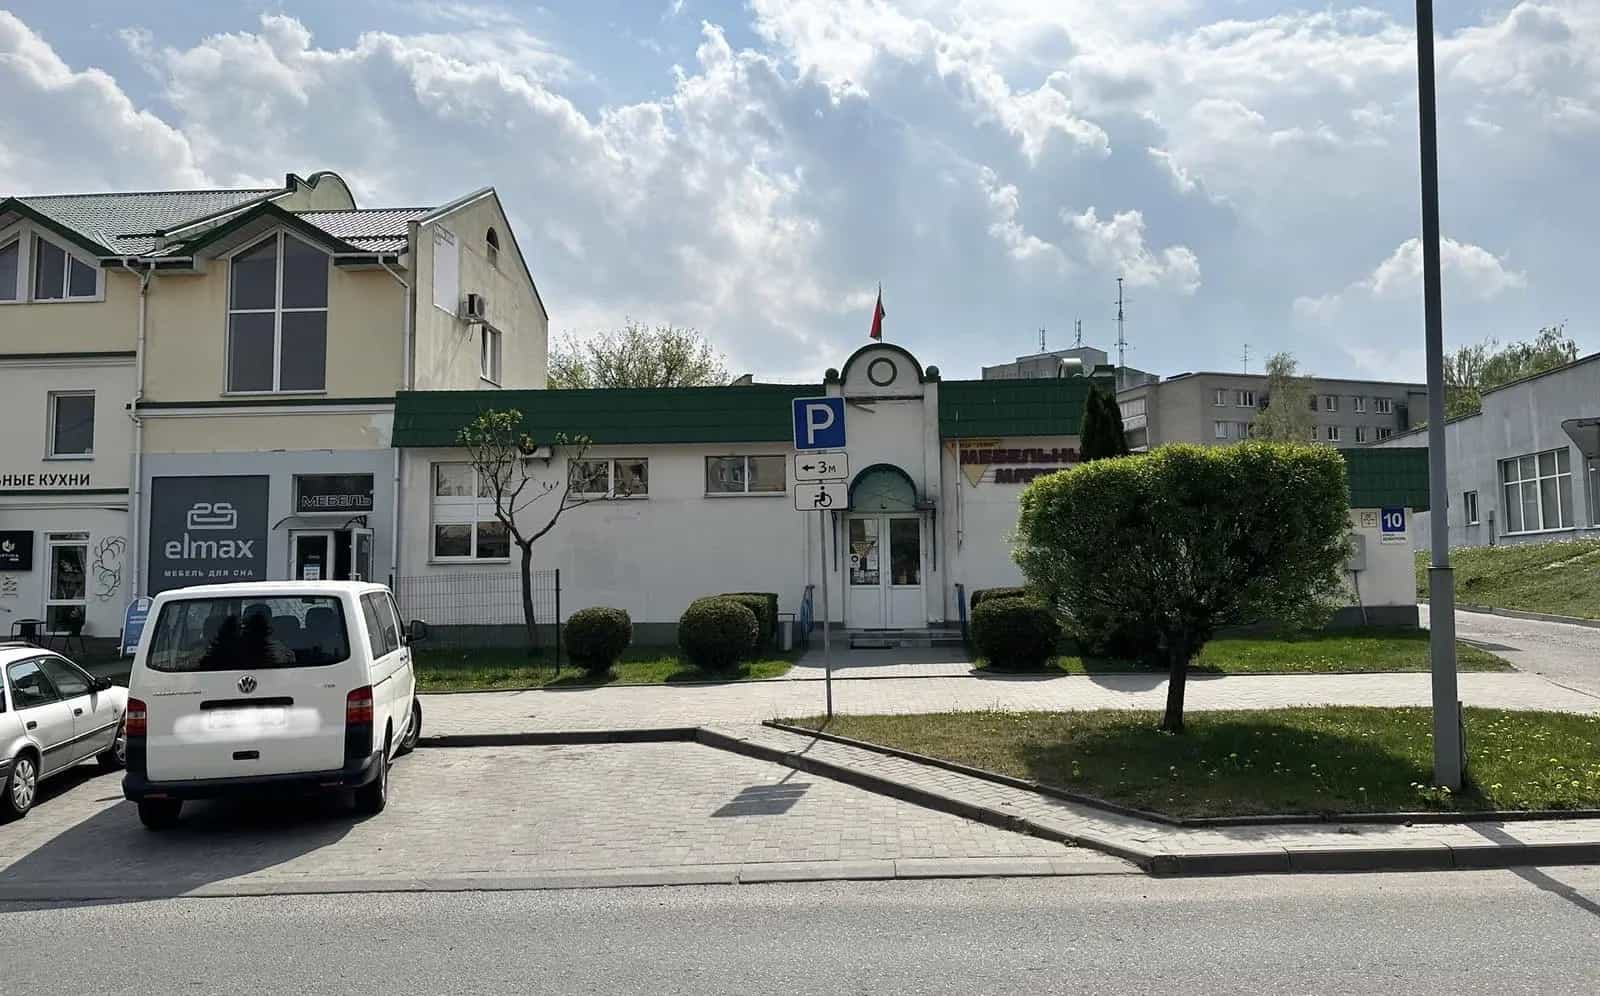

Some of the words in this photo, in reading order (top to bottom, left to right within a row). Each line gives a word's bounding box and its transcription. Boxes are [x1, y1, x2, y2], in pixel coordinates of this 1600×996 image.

[805, 403, 835, 445] P
[0, 473, 36, 487] НЫЕ
[39, 473, 91, 487] КУХНИ
[302, 494, 372, 507] МЕБЕЛЬ
[1383, 512, 1403, 529] 10
[164, 532, 255, 559] elmax
[164, 569, 205, 577] МЕБЕЛЬ
[208, 569, 229, 578] ДЛЯ
[233, 569, 254, 577] СНА
